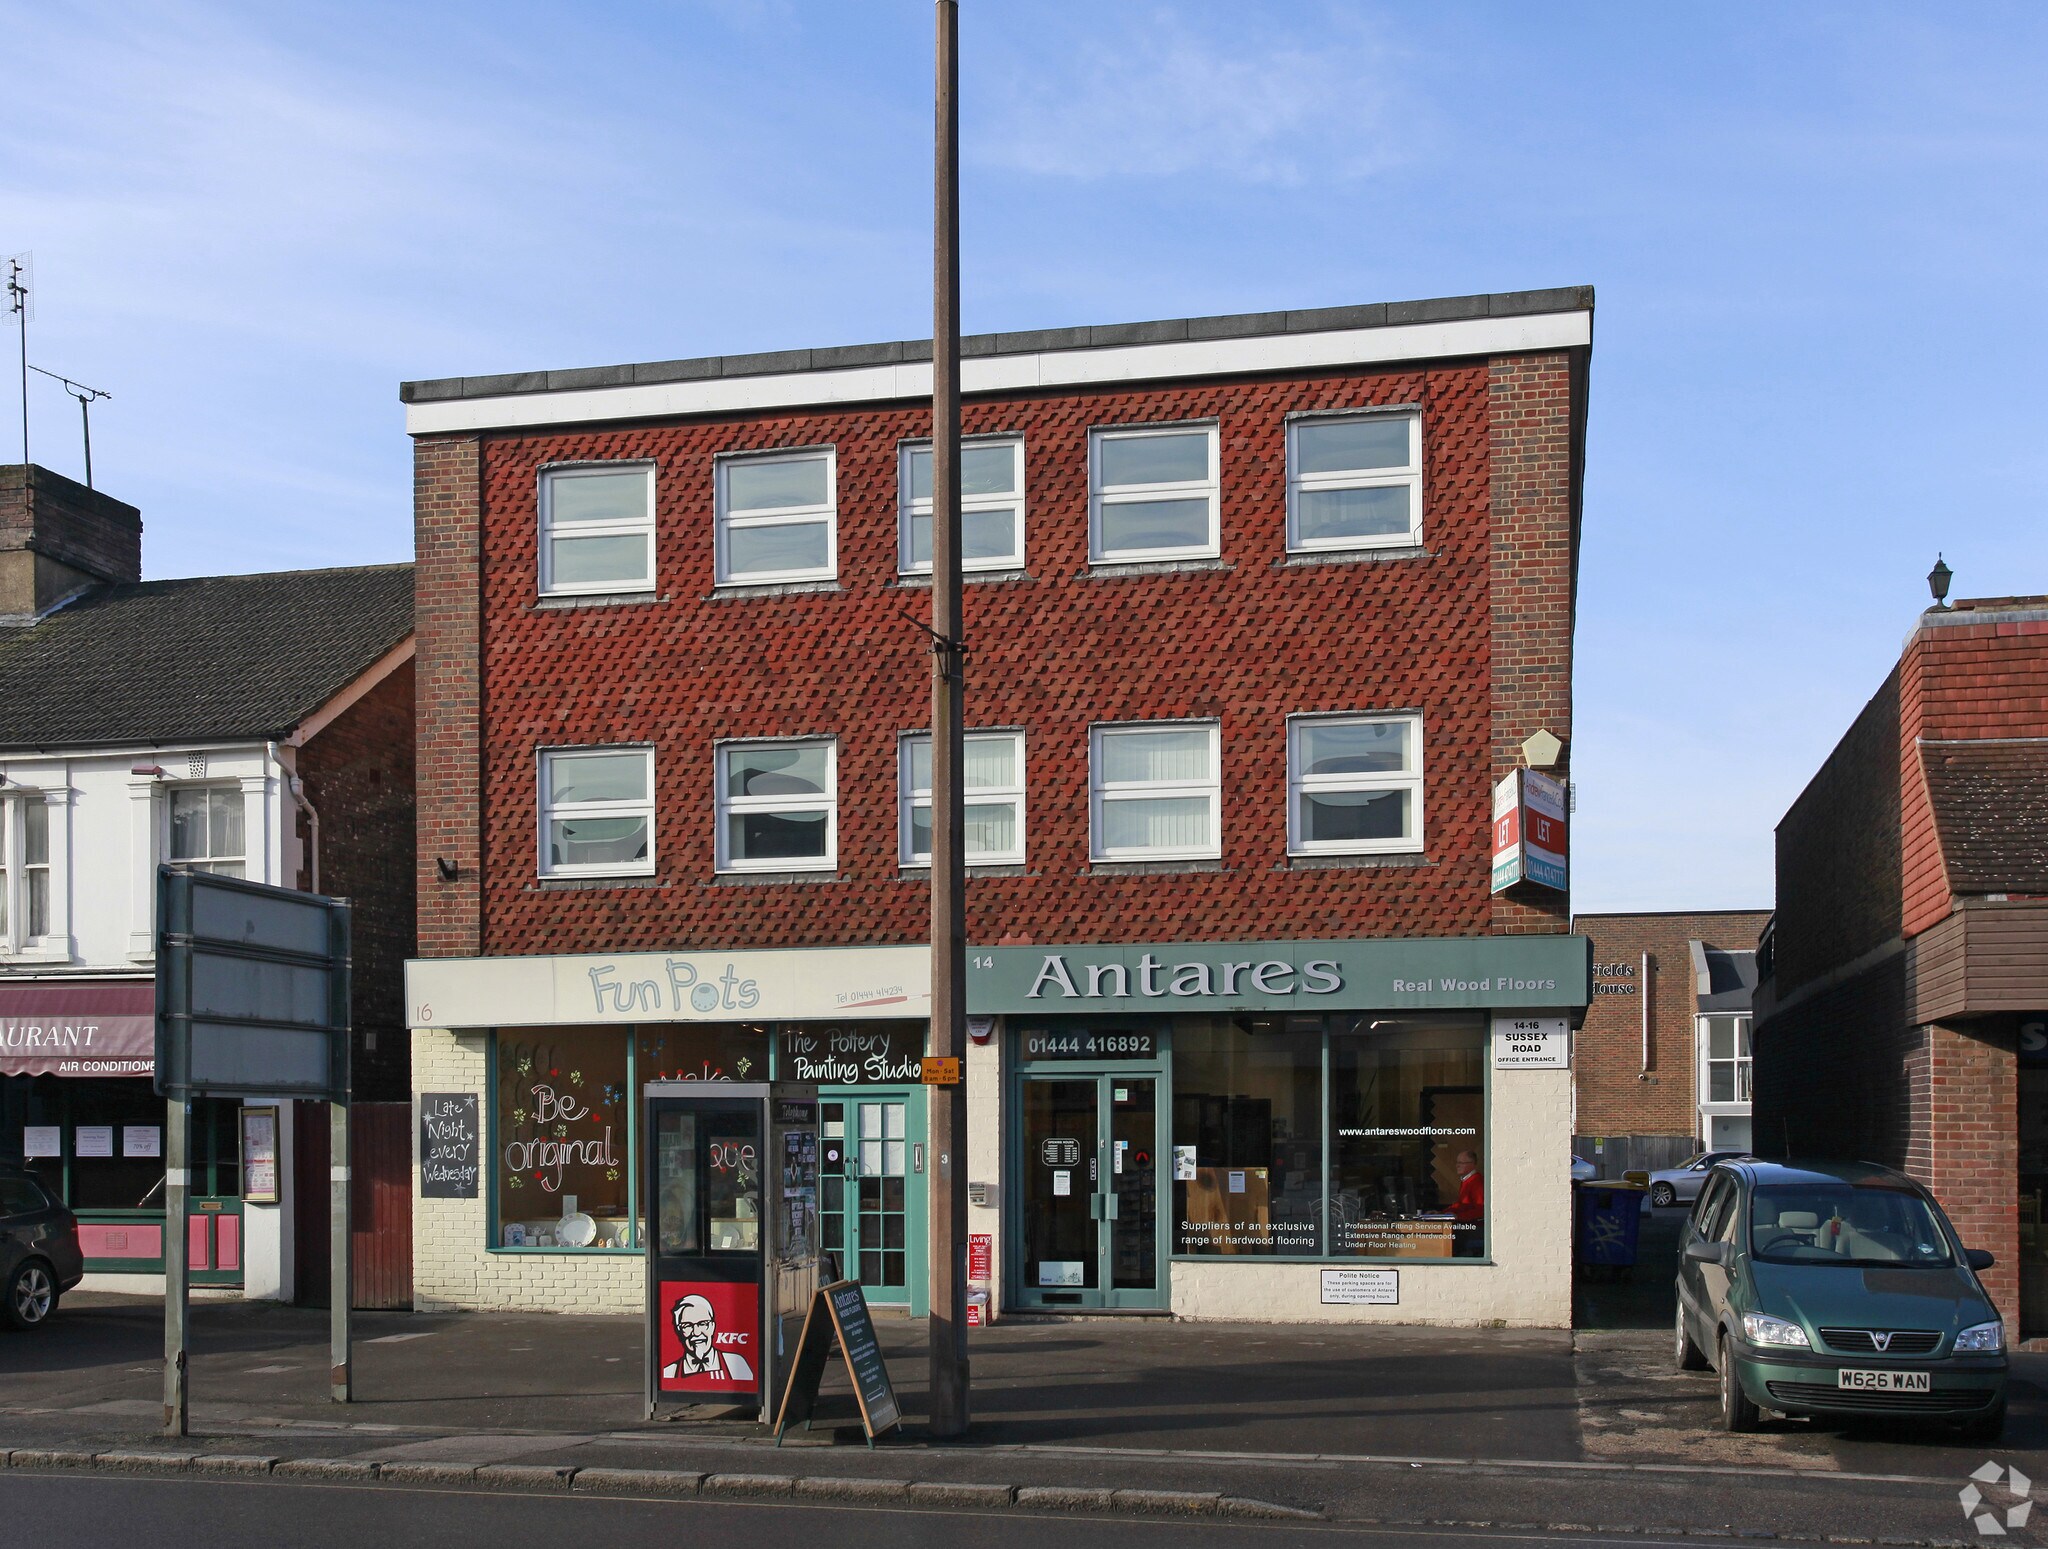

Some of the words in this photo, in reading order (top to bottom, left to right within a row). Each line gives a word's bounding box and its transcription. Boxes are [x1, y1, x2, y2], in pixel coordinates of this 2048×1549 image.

[1498, 818, 1510, 848] LET
[1536, 817, 1550, 844] LET
[973, 956, 994, 969] 14
[1025, 953, 1342, 998] Antares
[588, 965, 661, 1014] Fun
[666, 958, 760, 1013] Pots
[1393, 979, 1433, 992] Real
[1440, 978, 1490, 992] Wood
[1497, 977, 1556, 991] Floors
[836, 992, 848, 1004] Tel
[850, 990, 874, 1002] 01444
[876, 986, 903, 997] 414234
[417, 1004, 433, 1022] 16
[1514, 1022, 1540, 1030] 14-16
[787, 1029, 818, 1054] The
[824, 1027, 890, 1058] Pottery
[1028, 1037, 1080, 1053] 01444
[1086, 1036, 1150, 1052] 416892
[1505, 1032, 1548, 1042] SUSSEX
[1512, 1044, 1542, 1053] ROAD
[59, 1061, 80, 1072] AIR
[794, 1055, 858, 1084] Painting
[864, 1053, 921, 1083] Studio
[434, 1100, 463, 1116] Late
[531, 1084, 590, 1124] Be
[428, 1122, 466, 1140] Night
[1338, 1126, 1476, 1137] www.antareswoodfloors.com
[430, 1144, 470, 1160] every
[506, 1126, 620, 1192] original
[940, 1154, 948, 1164] 3
[423, 1164, 477, 1186] Wednesday
[1181, 1221, 1230, 1232] Suppliers
[1234, 1221, 1246, 1231] of
[1248, 1223, 1262, 1231] an
[1266, 1222, 1314, 1232] exclusive
[1344, 1222, 1388, 1230] Professional
[1390, 1222, 1413, 1232] Fitting
[1415, 1222, 1442, 1230] Service
[1444, 1222, 1476, 1231] Available
[1181, 1238, 1210, 1247] range
[1212, 1236, 1224, 1245] of
[1225, 1236, 1274, 1245] hardwood
[1277, 1236, 1314, 1248] flooring
[1344, 1232, 1379, 1240] Extensive
[1381, 1232, 1404, 1241] Range
[1406, 1232, 1414, 1240] of
[1416, 1232, 1456, 1240] Hardwoods
[1388, 1241, 1416, 1250] Heating
[834, 1288, 860, 1310] Antares
[716, 1332, 749, 1344] KFC
[1841, 1372, 1888, 1388] W626
[1893, 1374, 1928, 1390] WAN
